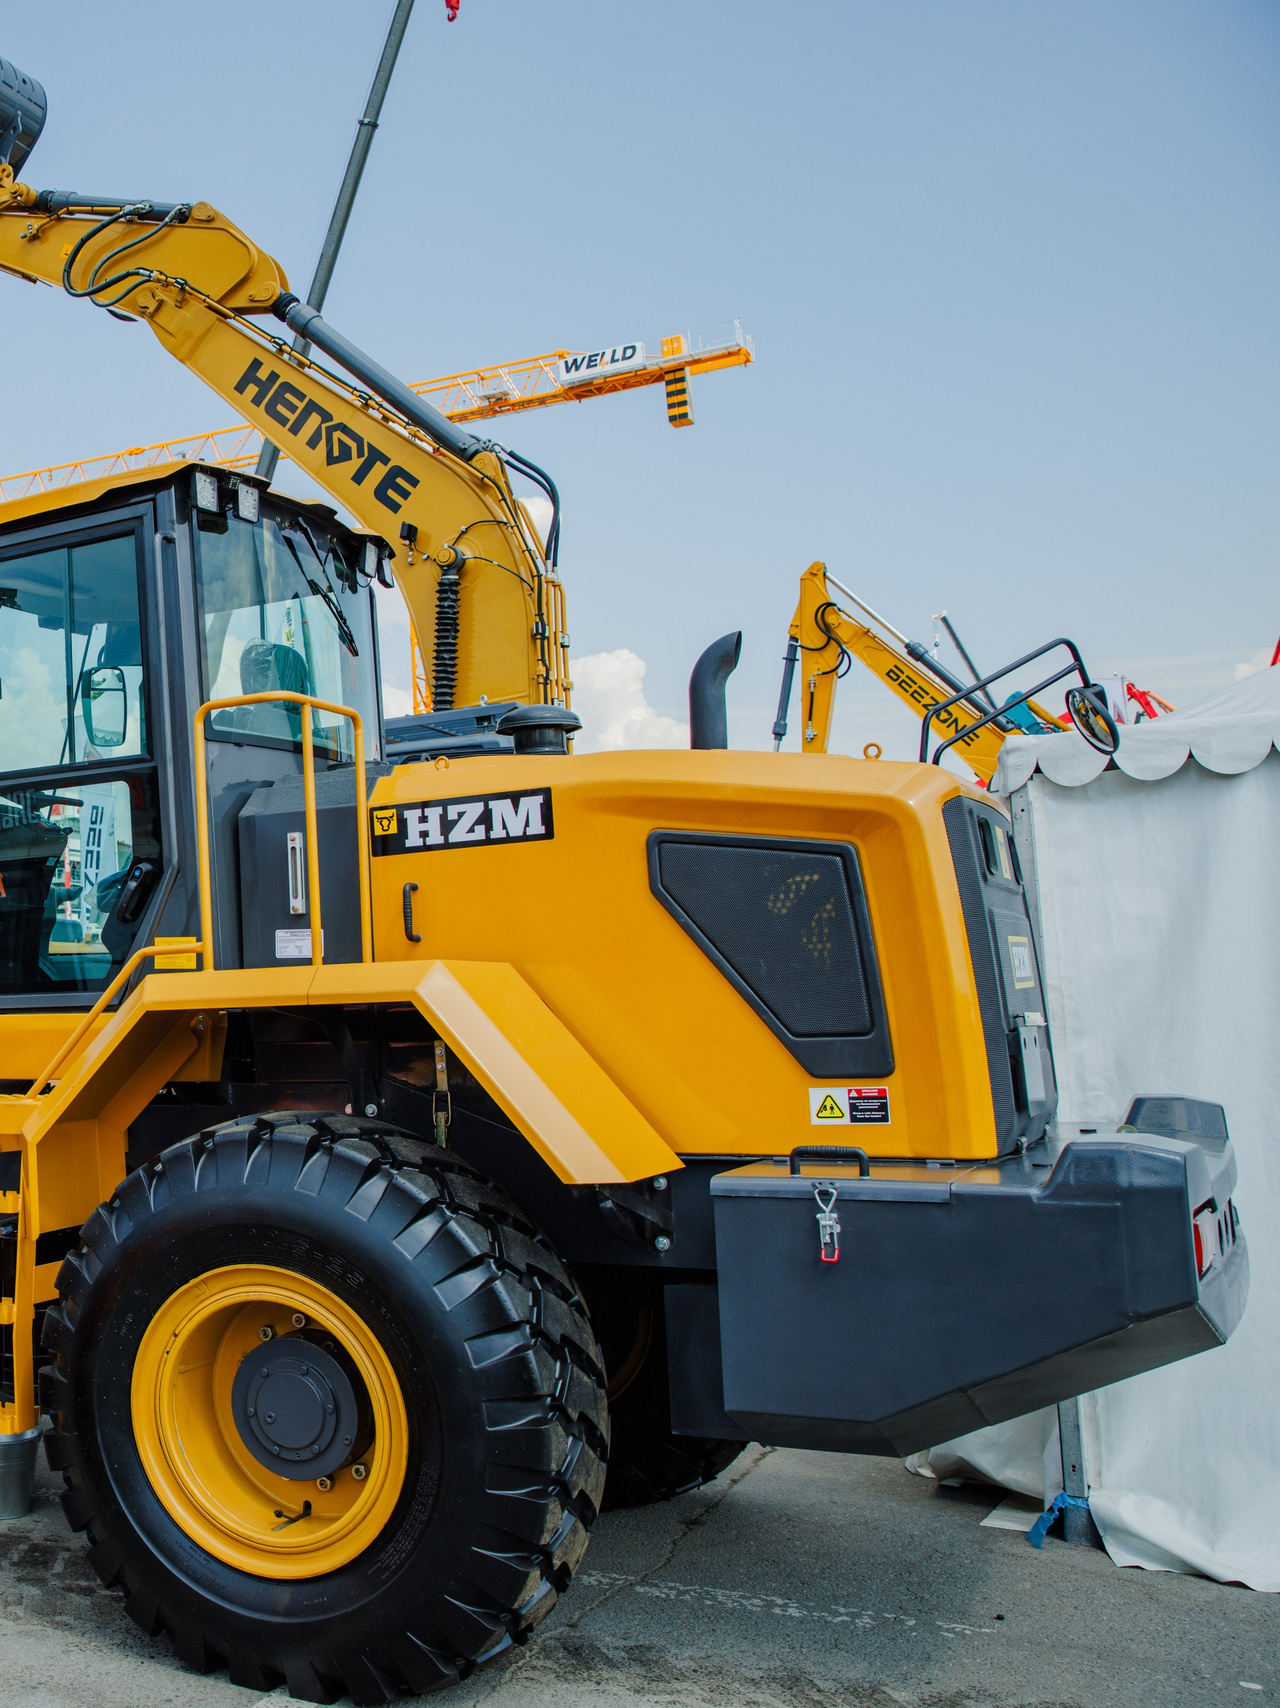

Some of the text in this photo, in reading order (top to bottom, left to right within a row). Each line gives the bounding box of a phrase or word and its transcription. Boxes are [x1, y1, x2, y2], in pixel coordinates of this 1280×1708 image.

[234, 357, 421, 515] HENGTE
[885, 664, 980, 747] BEEZONE
[403, 795, 546, 848] HZM
